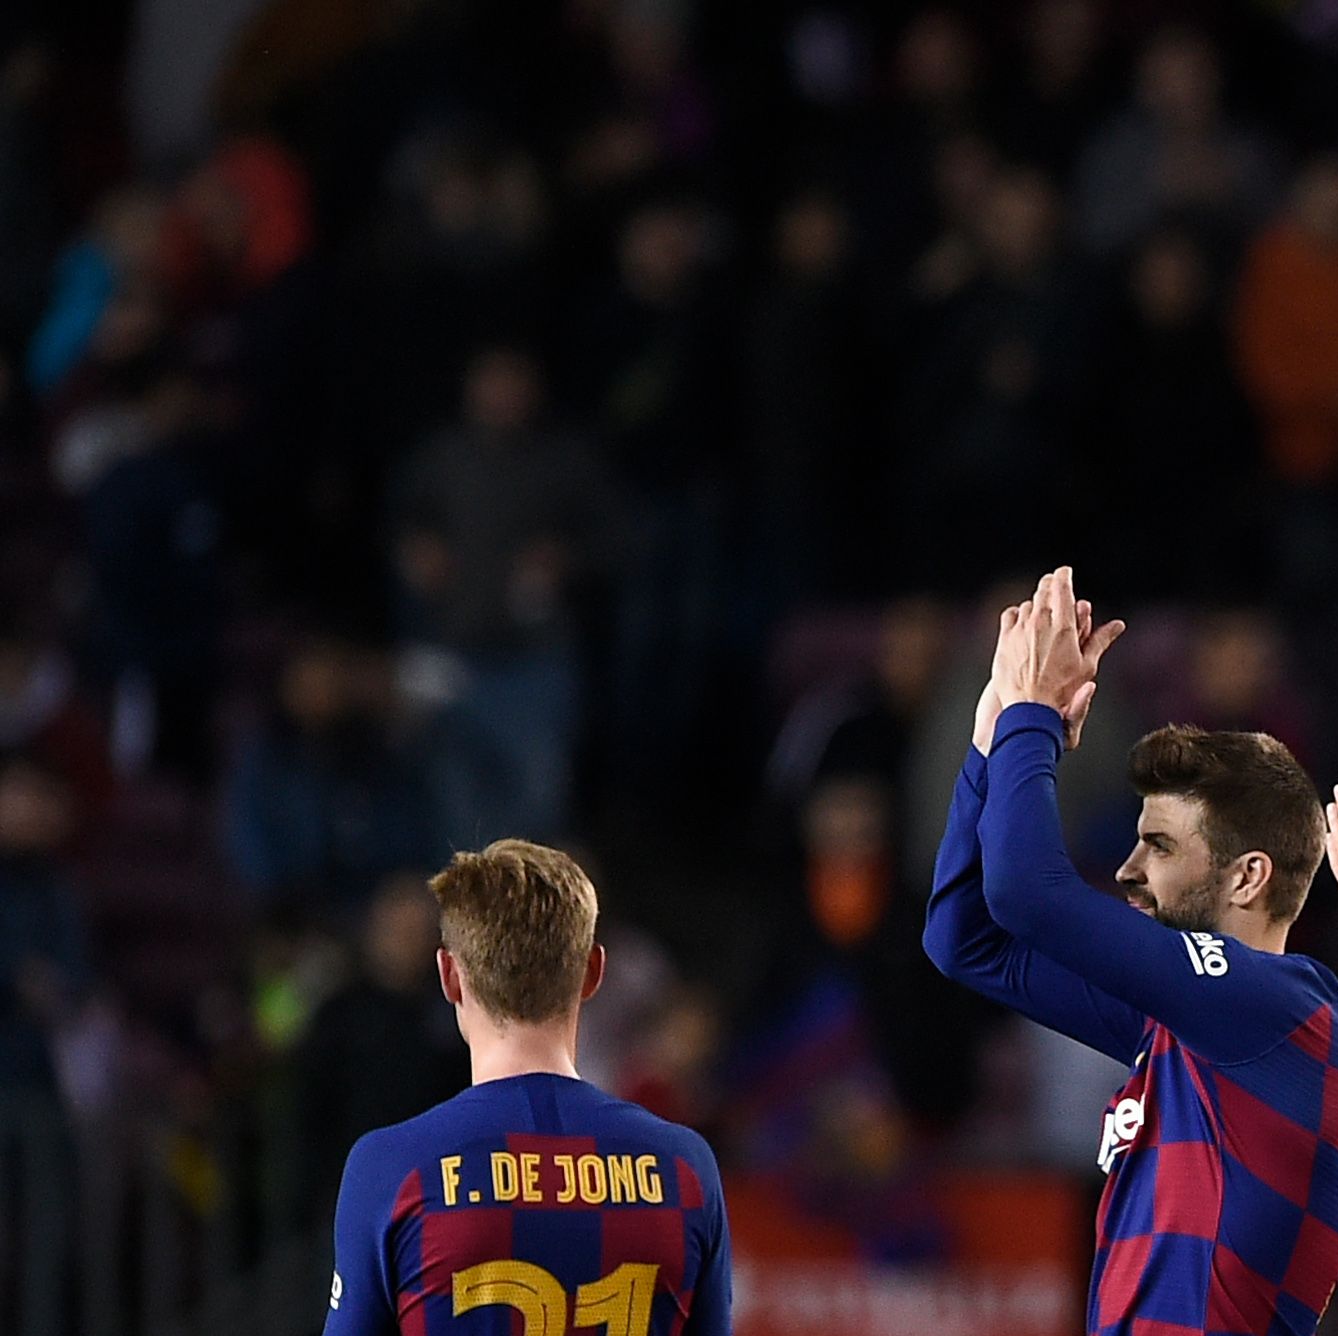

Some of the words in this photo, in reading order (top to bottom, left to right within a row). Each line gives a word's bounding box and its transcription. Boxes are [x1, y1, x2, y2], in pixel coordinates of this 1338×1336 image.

[440, 1154, 481, 1207] F.
[490, 1151, 544, 1203] DE
[553, 1153, 664, 1206] JONG
